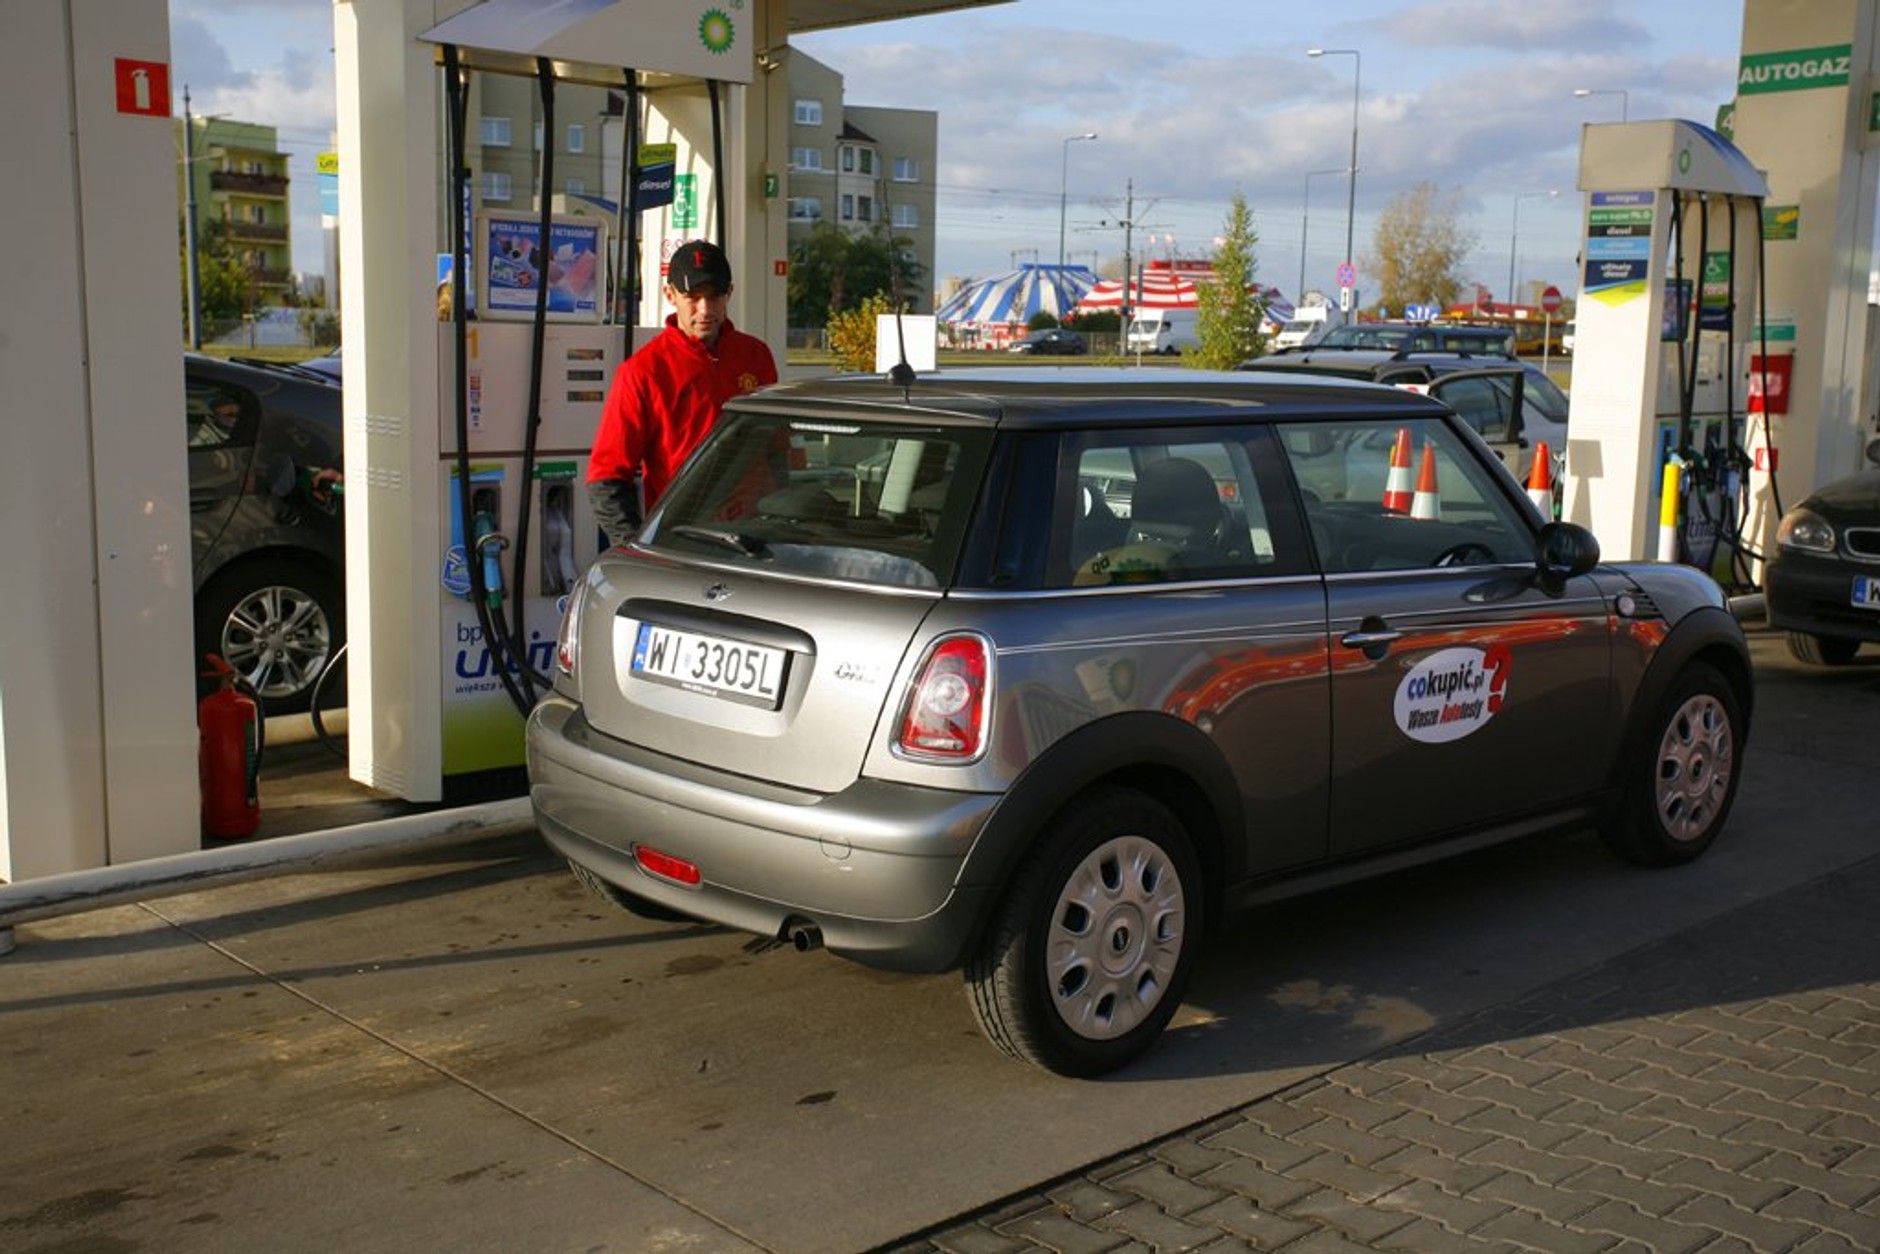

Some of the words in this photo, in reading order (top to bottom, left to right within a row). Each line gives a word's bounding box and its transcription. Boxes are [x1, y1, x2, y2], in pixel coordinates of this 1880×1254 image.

[1740, 57, 1851, 84] AUTOGAZ
[639, 179, 672, 191] diesel
[457, 622, 482, 645] bp
[649, 631, 683, 675] WI
[691, 640, 775, 695] 3305L
